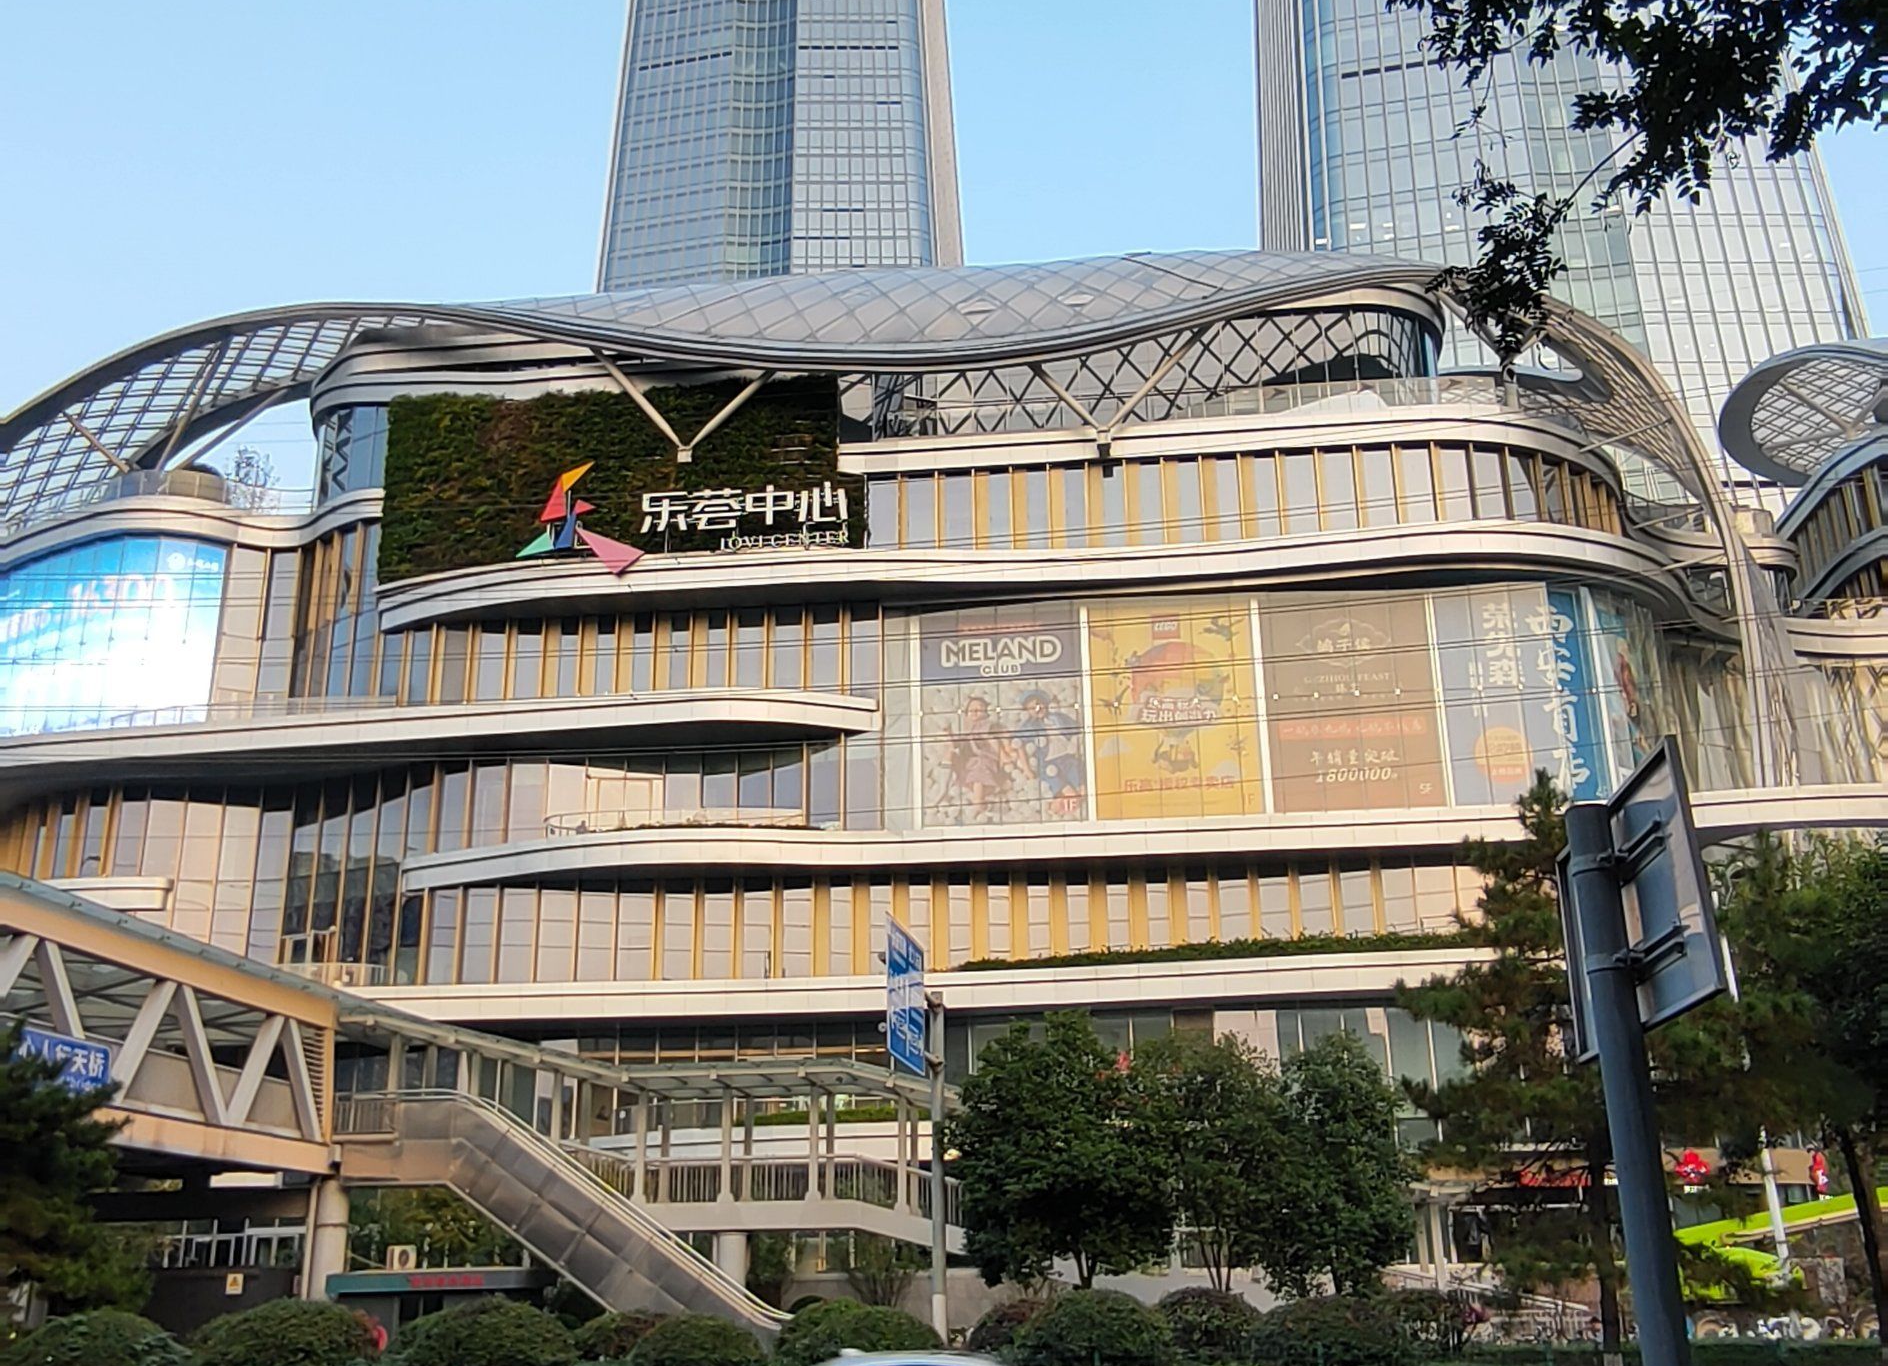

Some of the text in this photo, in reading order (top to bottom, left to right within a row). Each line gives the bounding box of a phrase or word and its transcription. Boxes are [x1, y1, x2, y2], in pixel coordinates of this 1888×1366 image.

[640, 481, 849, 534] 乐荟中心
[771, 530, 850, 547] CENTER
[942, 636, 1061, 667] MELAND
[981, 664, 1020, 675] CLUB
